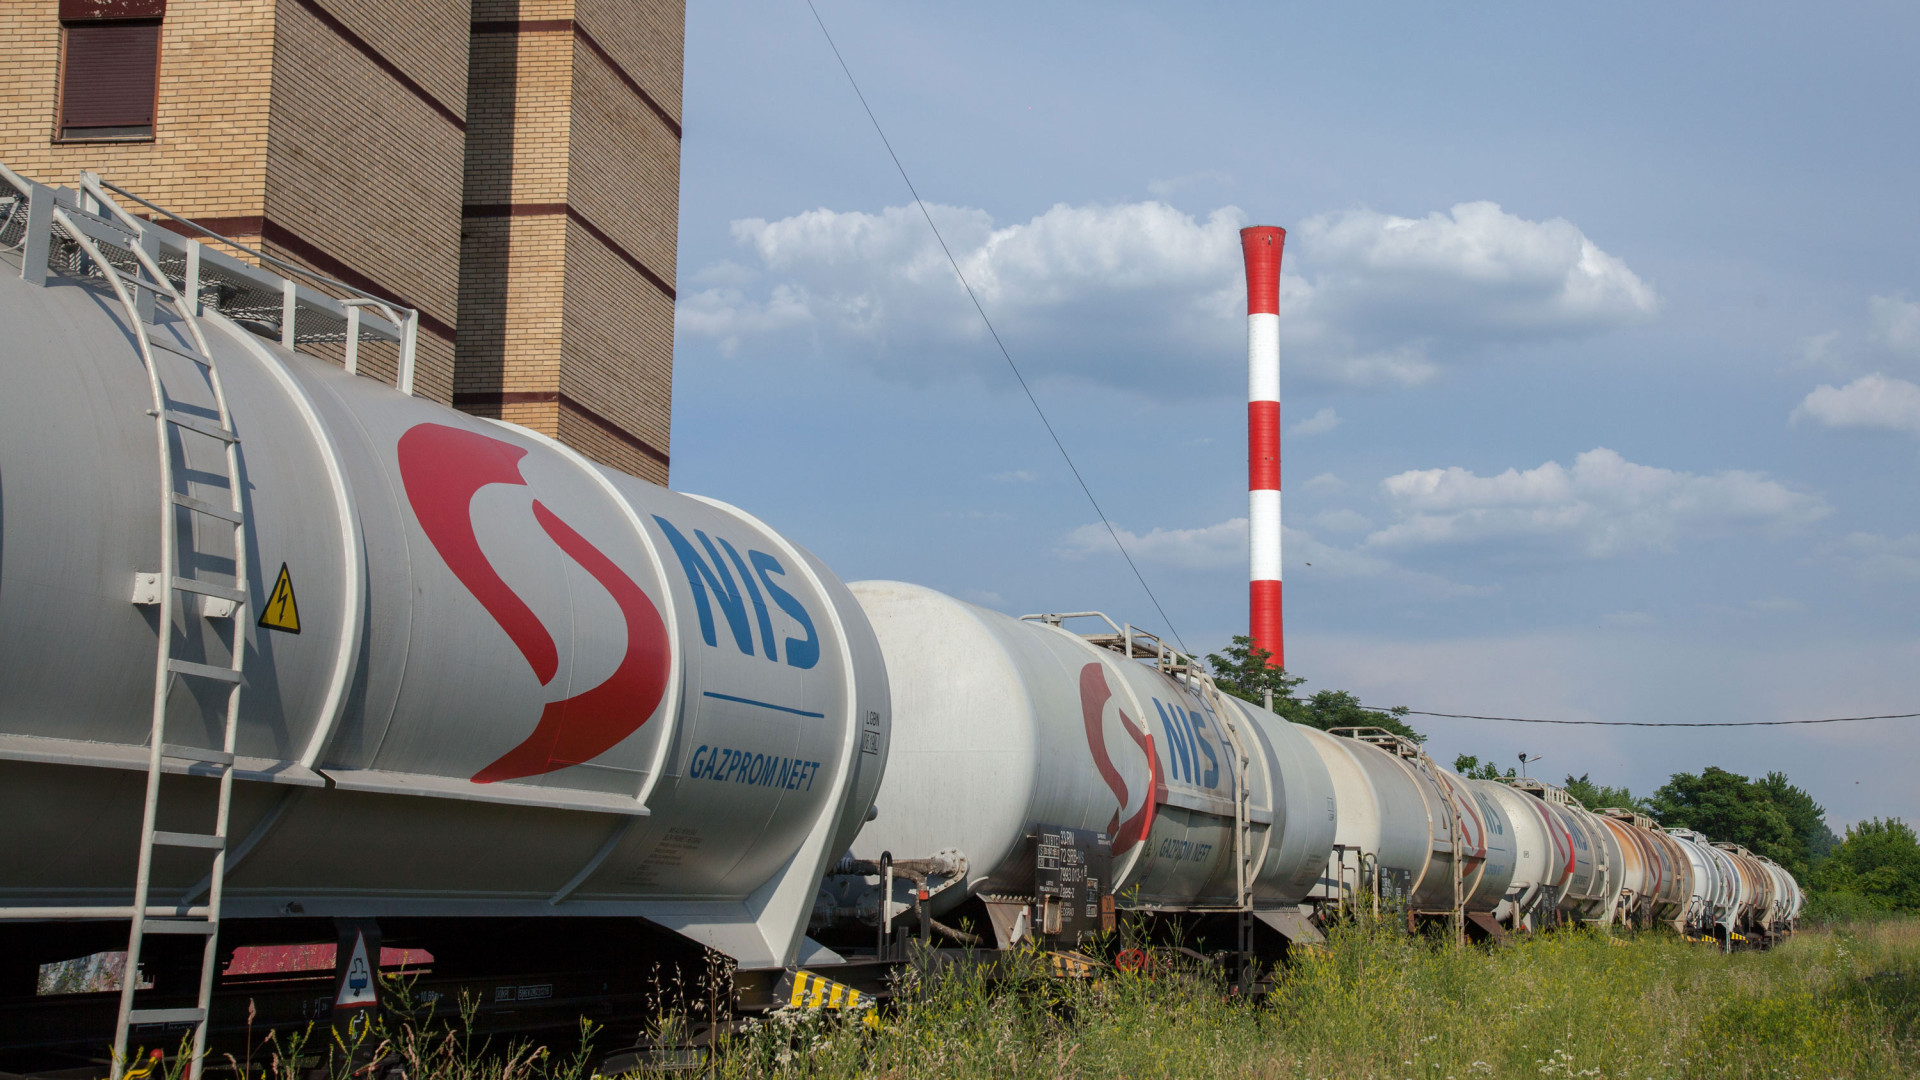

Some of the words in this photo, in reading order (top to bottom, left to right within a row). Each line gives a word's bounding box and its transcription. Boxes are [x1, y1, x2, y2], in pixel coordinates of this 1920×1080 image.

[651, 513, 820, 670] NIS
[690, 744, 780, 788] GAZPROM
[774, 757, 821, 792] NEFT
[1152, 696, 1219, 790] NIS
[1159, 837, 1195, 862] GAZPROM
[1191, 841, 1213, 863] NEFT
